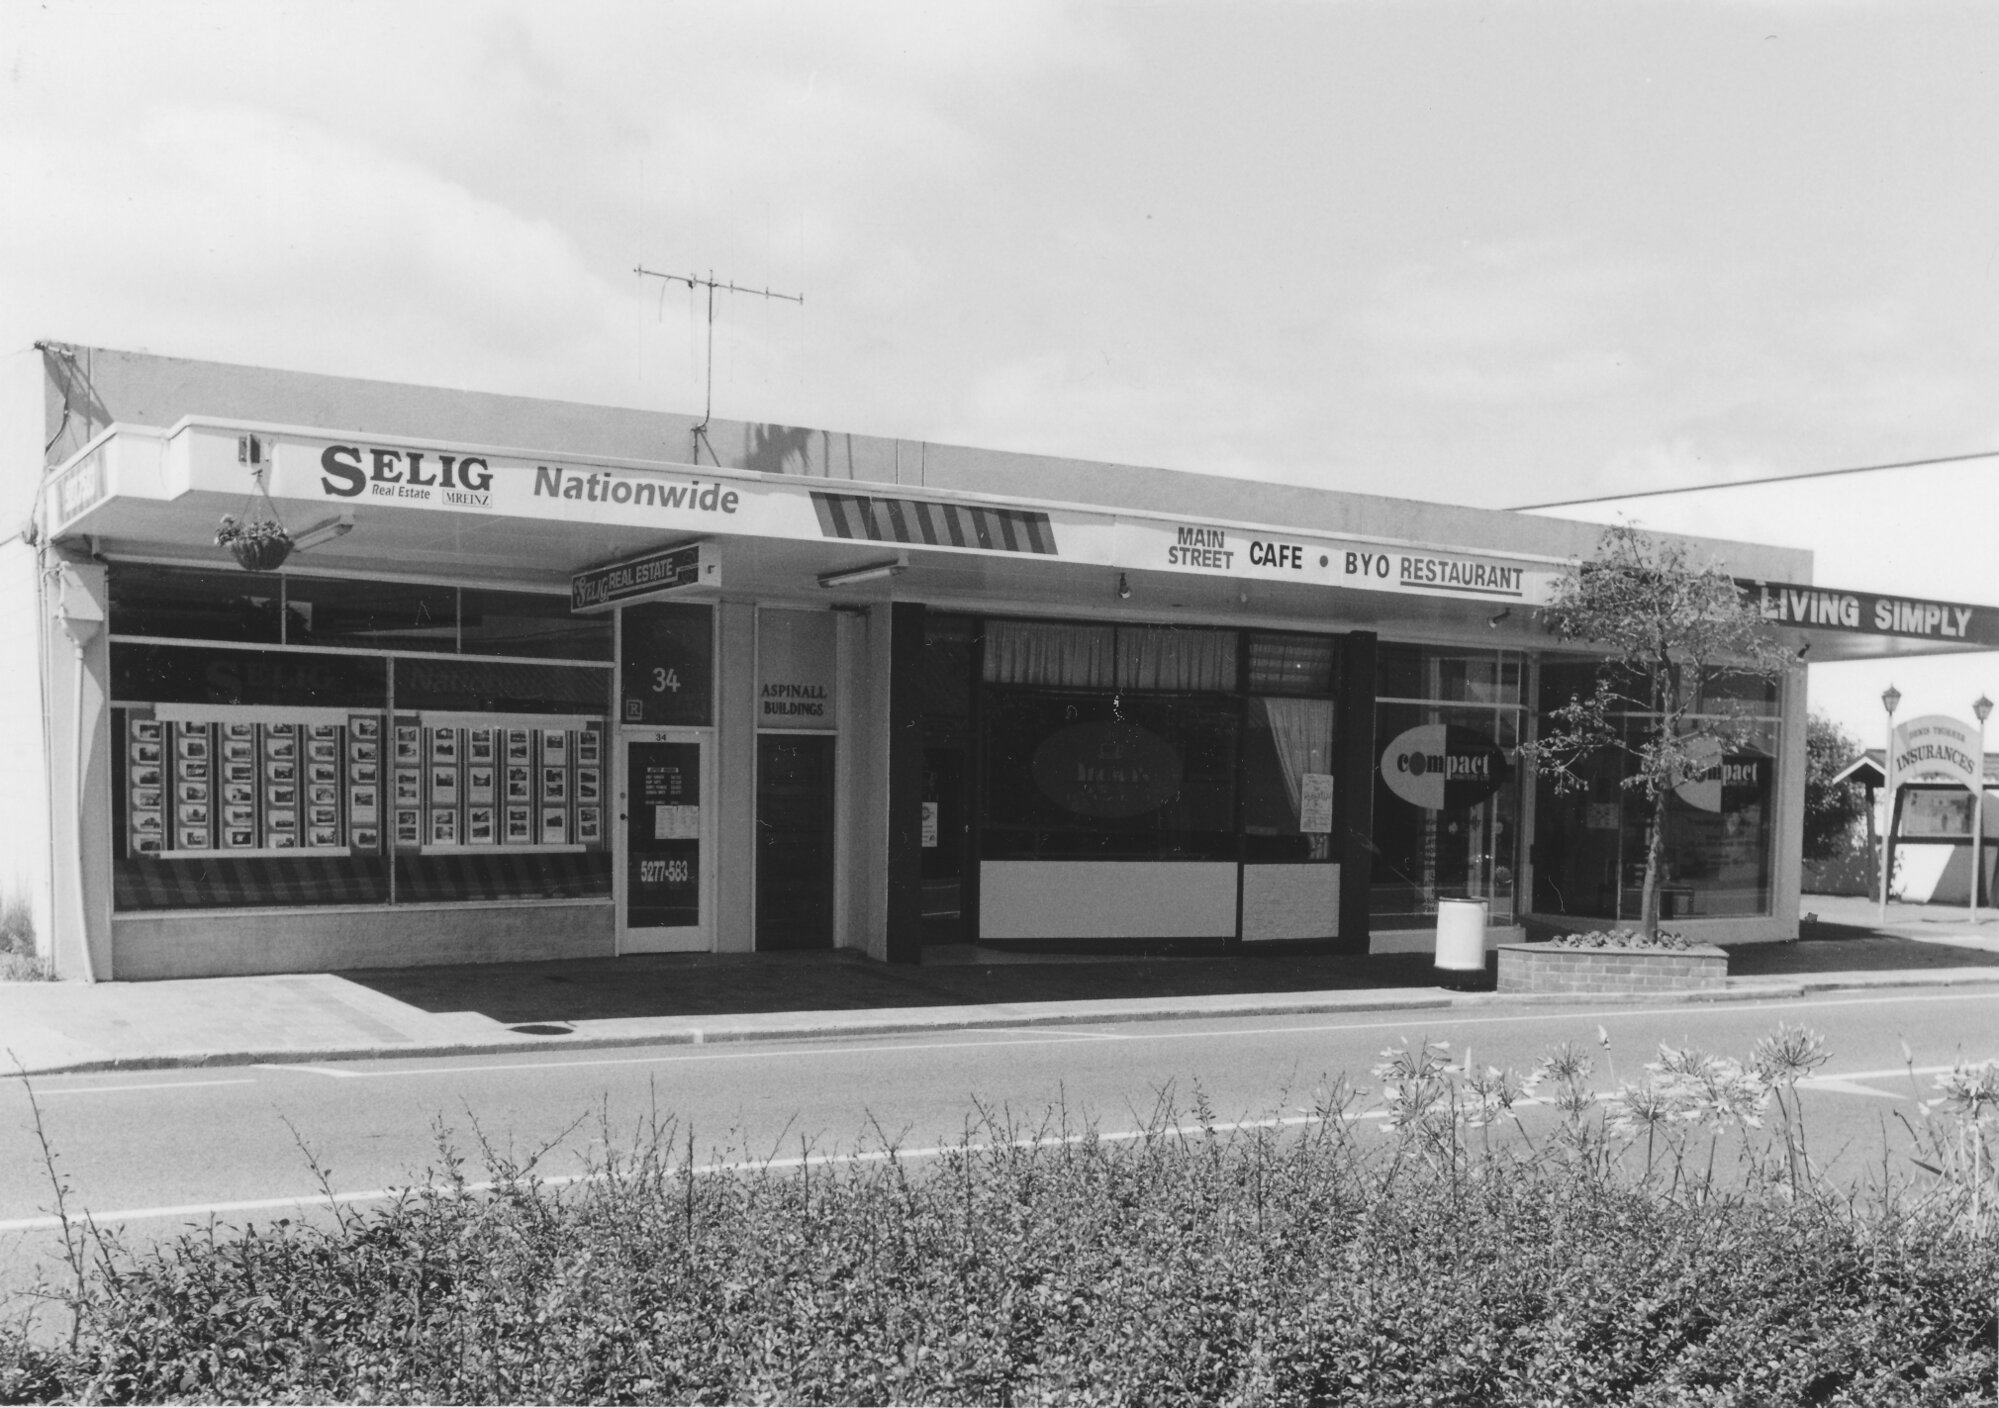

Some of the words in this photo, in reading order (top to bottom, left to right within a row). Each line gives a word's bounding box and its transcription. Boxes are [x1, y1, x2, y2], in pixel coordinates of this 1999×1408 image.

[320, 444, 494, 498] SELIG
[372, 483, 395, 498] Real
[399, 485, 431, 501] Estate
[445, 491, 490, 507] MREINZ
[533, 465, 740, 514] Nationwide
[1177, 526, 1225, 549] MAIN
[1168, 545, 1234, 570] STREET
[1249, 540, 1303, 570] CAFE
[1344, 551, 1390, 578] BYO
[1400, 556, 1523, 591] RESTAURANT
[608, 568, 634, 590] REAL
[635, 557, 673, 584] ESTATE
[1760, 586, 1860, 628] LIVING
[1874, 598, 1973, 638] SIMPLY
[652, 667, 681, 693] 34
[761, 683, 828, 700] ASPINALL
[764, 701, 824, 717] BUILDINGS
[655, 733, 667, 742] 34
[1896, 743, 1976, 775] INSURANCES
[641, 860, 688, 882] 5277-583
